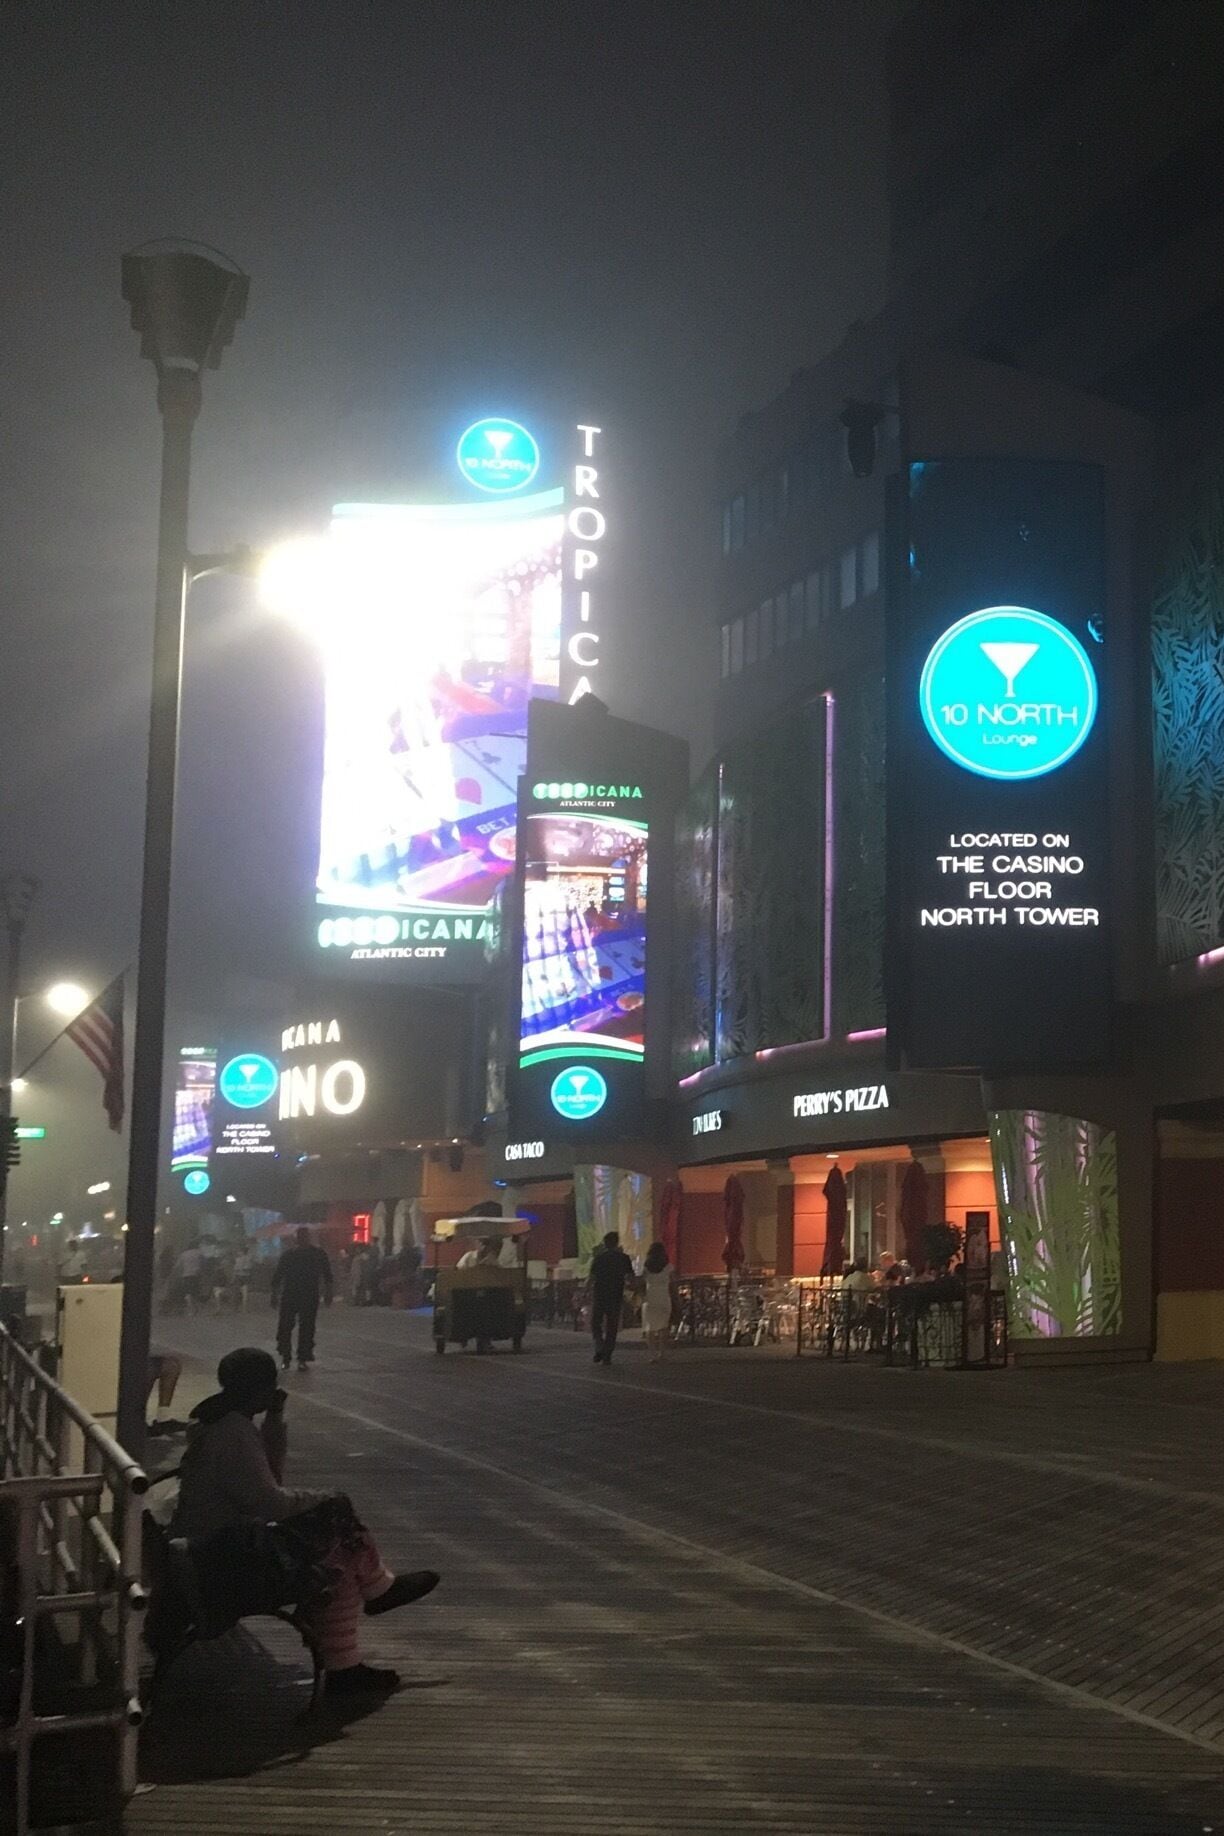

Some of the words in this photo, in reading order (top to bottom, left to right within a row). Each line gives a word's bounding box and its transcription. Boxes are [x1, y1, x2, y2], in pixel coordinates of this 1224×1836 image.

[941, 704, 968, 726] 10
[977, 703, 1078, 726] NORTH
[983, 733, 1038, 747] Lounge
[950, 834, 1037, 848] LOCATED
[1042, 834, 1070, 848] ON
[936, 856, 985, 873] THE
[992, 855, 1085, 874] CASINO
[969, 881, 1052, 899] FLOOR
[921, 907, 1006, 926] NORTH
[1014, 907, 1100, 926] TOWER
[350, 948, 412, 959] ATLANTIC
[415, 947, 447, 957] CITY
[793, 1090, 843, 1117] PERRY'S
[845, 1085, 889, 1112] PIZZA
